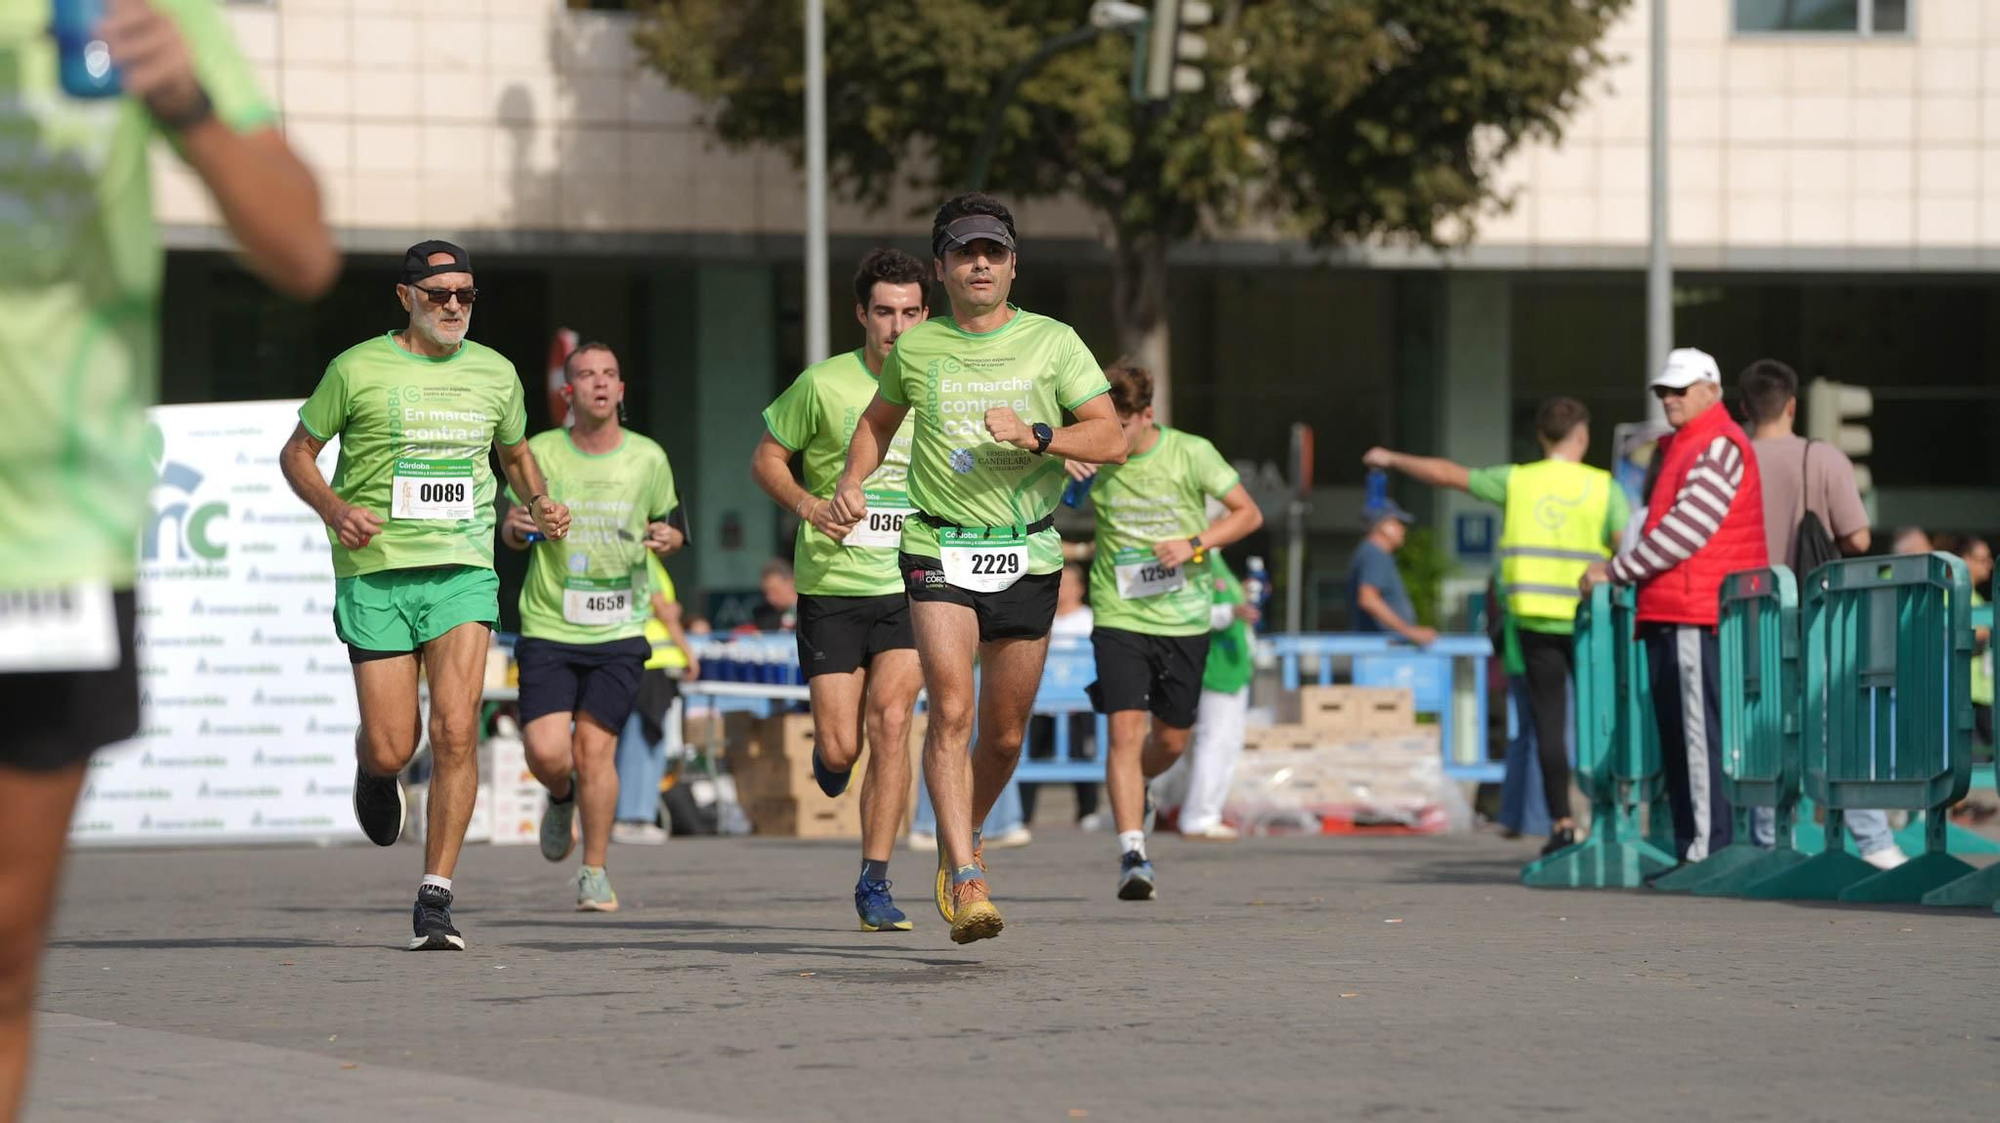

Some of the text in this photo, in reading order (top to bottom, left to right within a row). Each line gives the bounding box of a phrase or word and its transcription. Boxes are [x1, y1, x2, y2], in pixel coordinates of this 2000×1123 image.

[941, 376, 1033, 393] En marcha
[1012, 394, 1031, 412] el
[405, 406, 486, 422] En marcha
[405, 426, 484, 441] contra el
[399, 462, 430, 470] Córdoba
[978, 456, 1032, 466] CANDELARIA
[421, 484, 465, 502] 0089
[870, 514, 903, 532] 036
[945, 531, 977, 539] Códoba
[972, 553, 1019, 574] 2229
[586, 596, 624, 611] 4658
